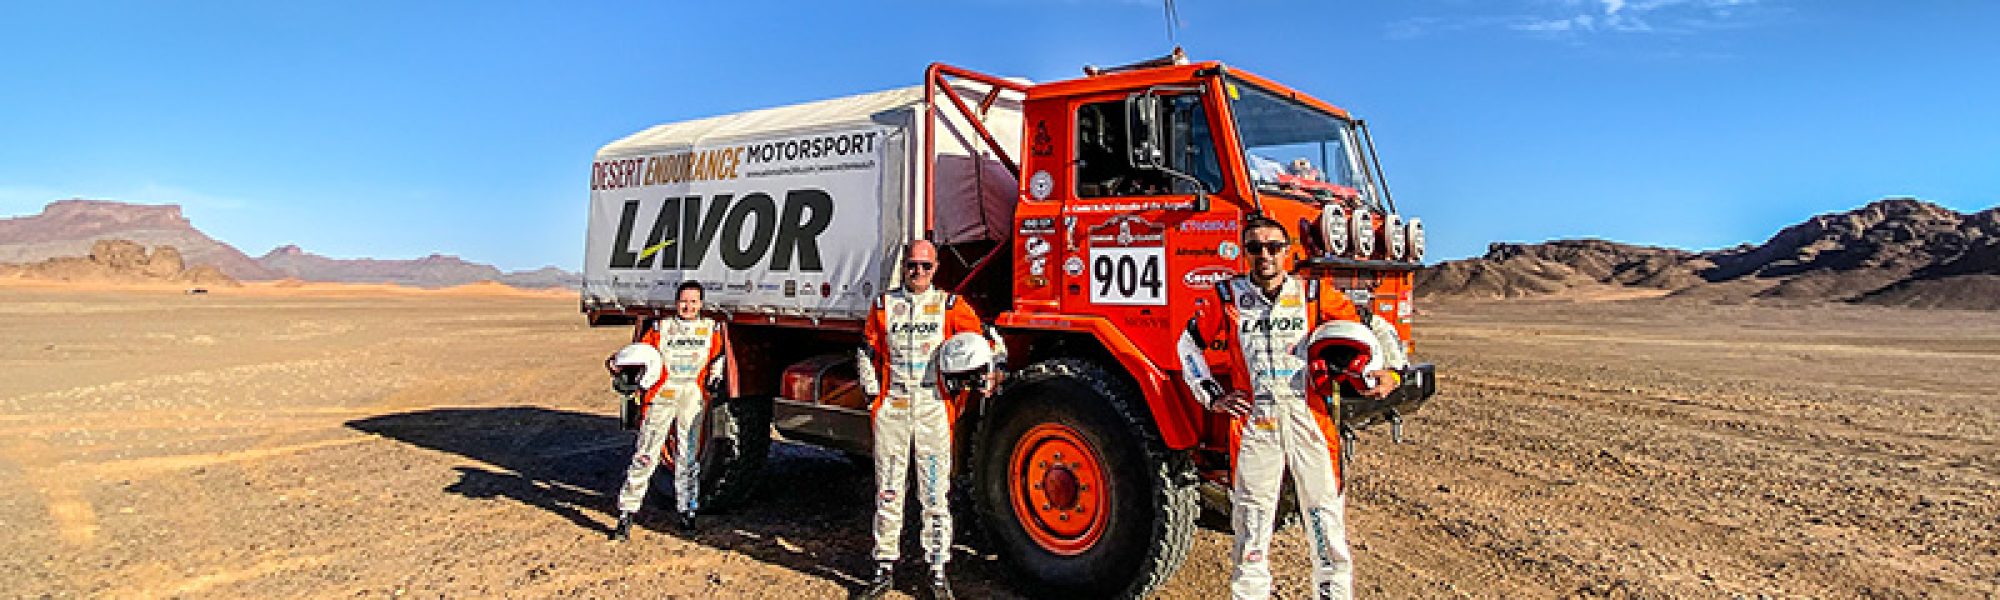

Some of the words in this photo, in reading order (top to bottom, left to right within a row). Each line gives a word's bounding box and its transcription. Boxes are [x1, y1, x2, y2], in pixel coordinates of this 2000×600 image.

[591, 157, 645, 190] DESERT
[645, 147, 745, 185] ENDURANCE
[747, 132, 877, 165] MOTORSPORT
[609, 188, 834, 271] LAVOR
[1094, 253, 1163, 299] 904
[1241, 317, 1305, 333] LAVOR
